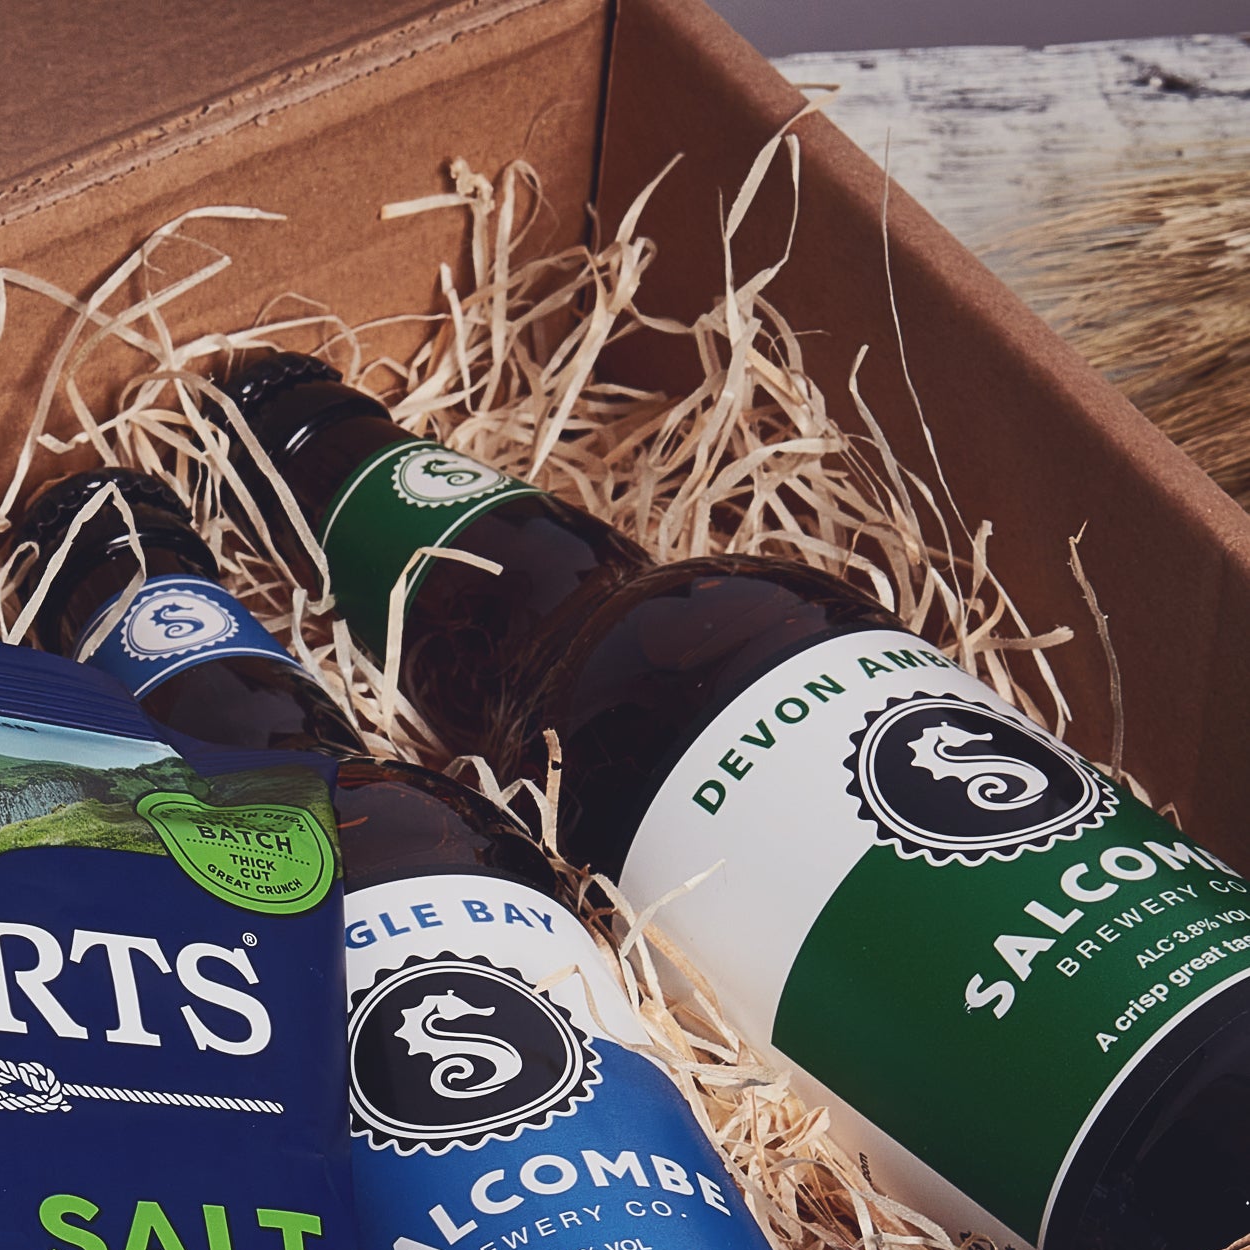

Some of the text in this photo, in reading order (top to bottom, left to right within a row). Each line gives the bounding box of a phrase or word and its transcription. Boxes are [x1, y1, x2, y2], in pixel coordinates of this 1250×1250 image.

[691, 649, 966, 815] DEVON AMB
[196, 825, 293, 855] BATCH
[263, 812, 307, 833] DEVON
[208, 863, 303, 895] GREAT CRUNCH
[229, 854, 277, 872] THICK
[240, 868, 271, 882] CUT
[344, 899, 555, 949] GLE BAY
[962, 840, 1244, 1020] SALCOMB
[1056, 884, 1198, 978] BREWERY
[1135, 938, 1175, 969] ALC
[1173, 918, 1220, 943] 3.8%
[1095, 934, 1250, 1053] A crisp great tas
[625, 1200, 688, 1219] CO.
